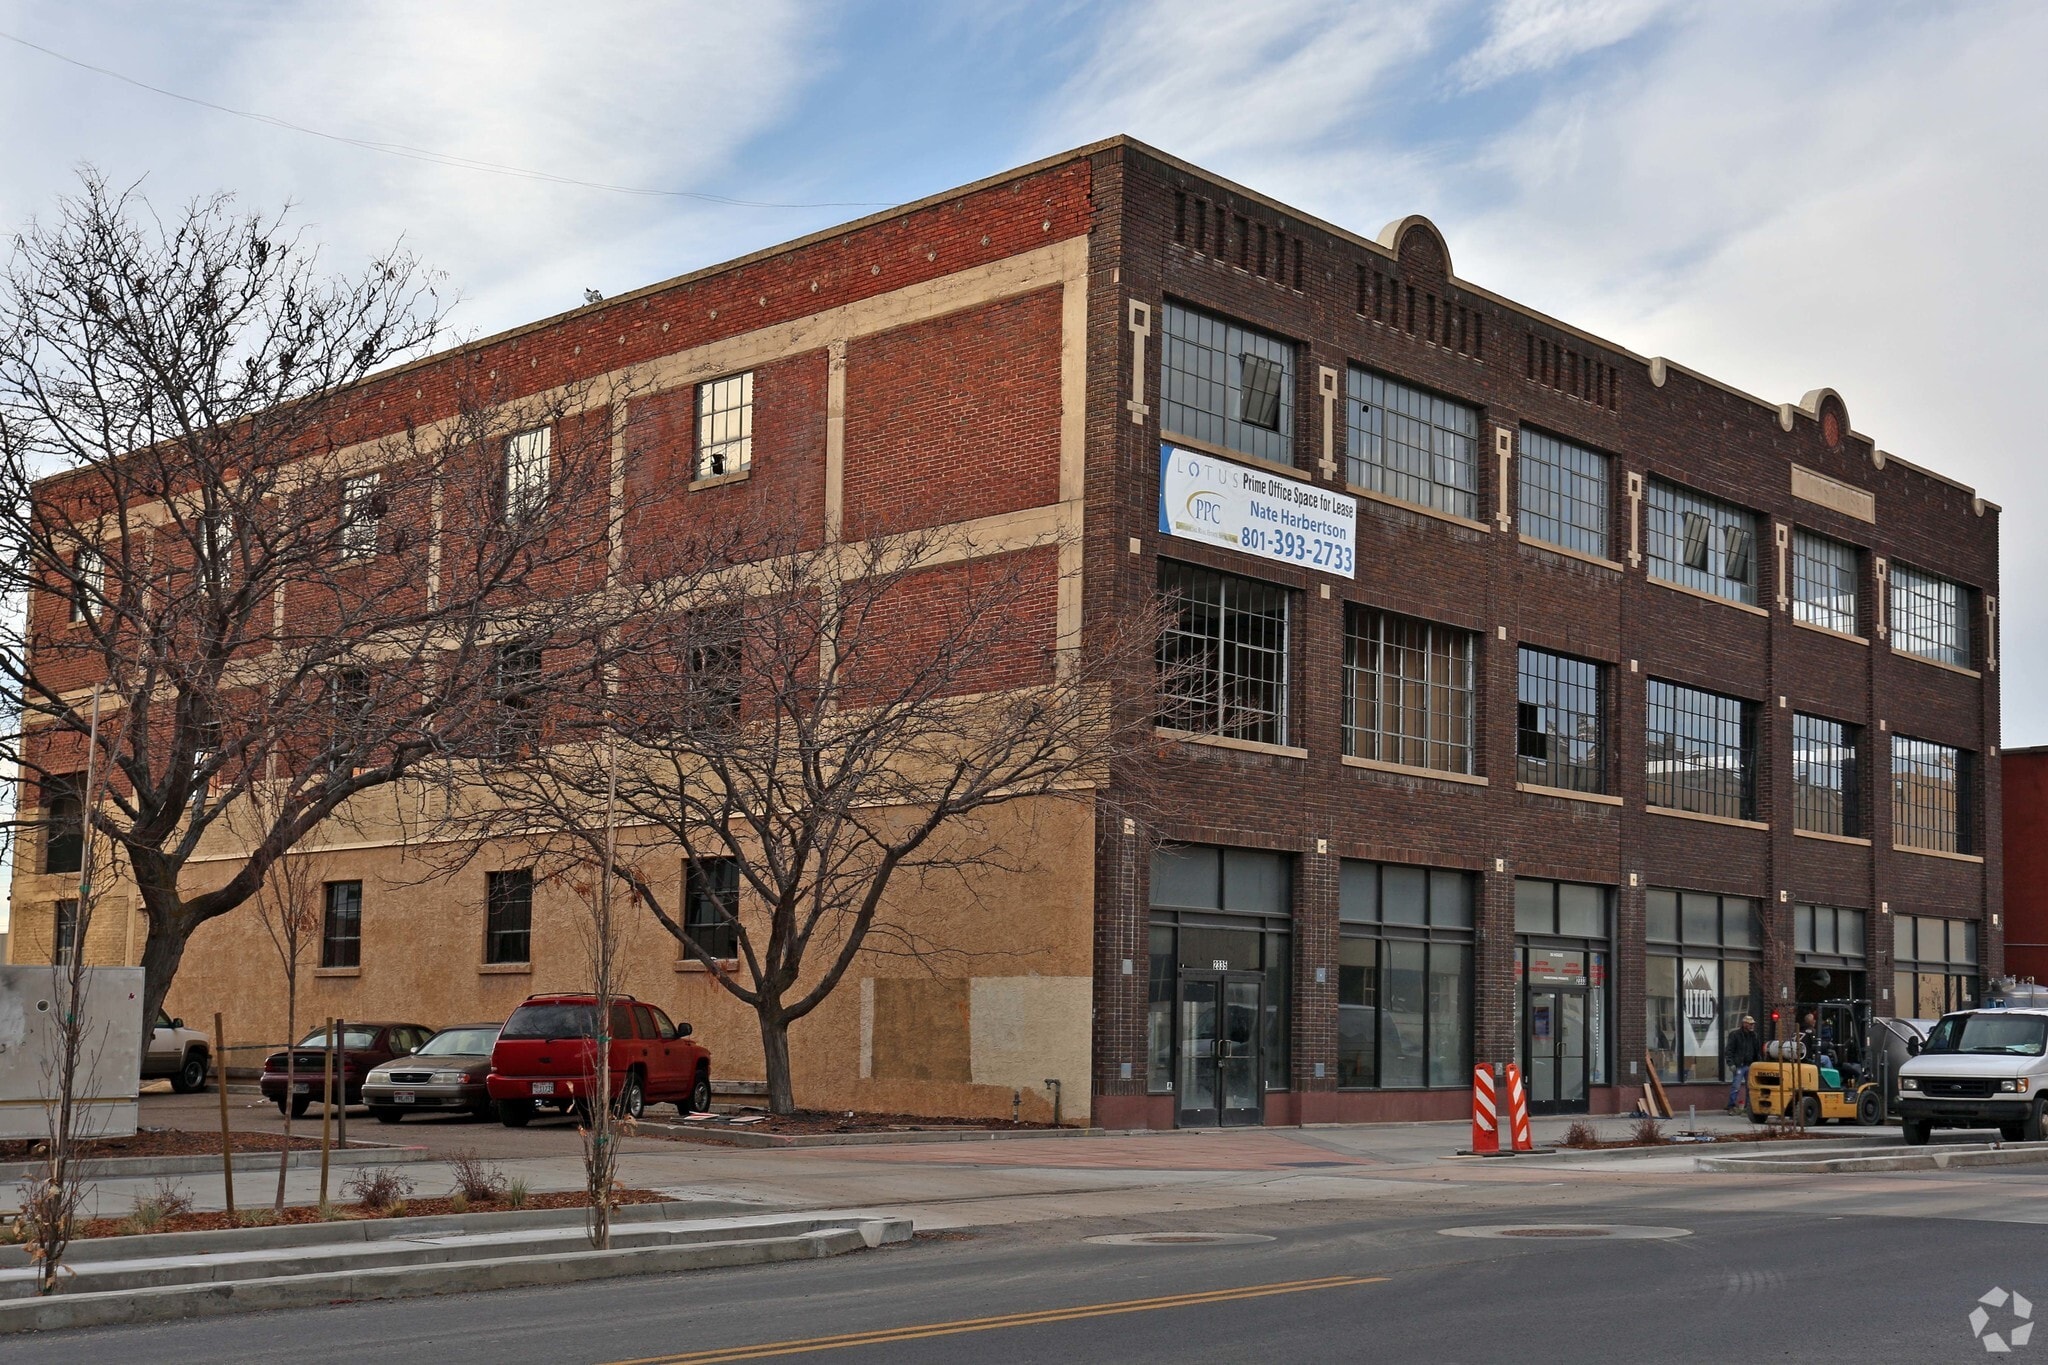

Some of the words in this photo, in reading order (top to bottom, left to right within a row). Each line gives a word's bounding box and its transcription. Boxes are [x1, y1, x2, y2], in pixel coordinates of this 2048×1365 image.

[1177, 457, 1239, 488] LOTUS
[1195, 498, 1221, 525] PPC
[1243, 472, 1266, 494] Prime
[1268, 479, 1292, 502] Office
[1294, 487, 1318, 508] Space
[1320, 494, 1331, 512] for
[1332, 497, 1354, 519] Lease
[1250, 500, 1278, 522] Nate
[1281, 508, 1346, 540] Harbertson
[1241, 526, 1353, 573] 801-393-2733
[1685, 988, 1713, 1018] UTOG
